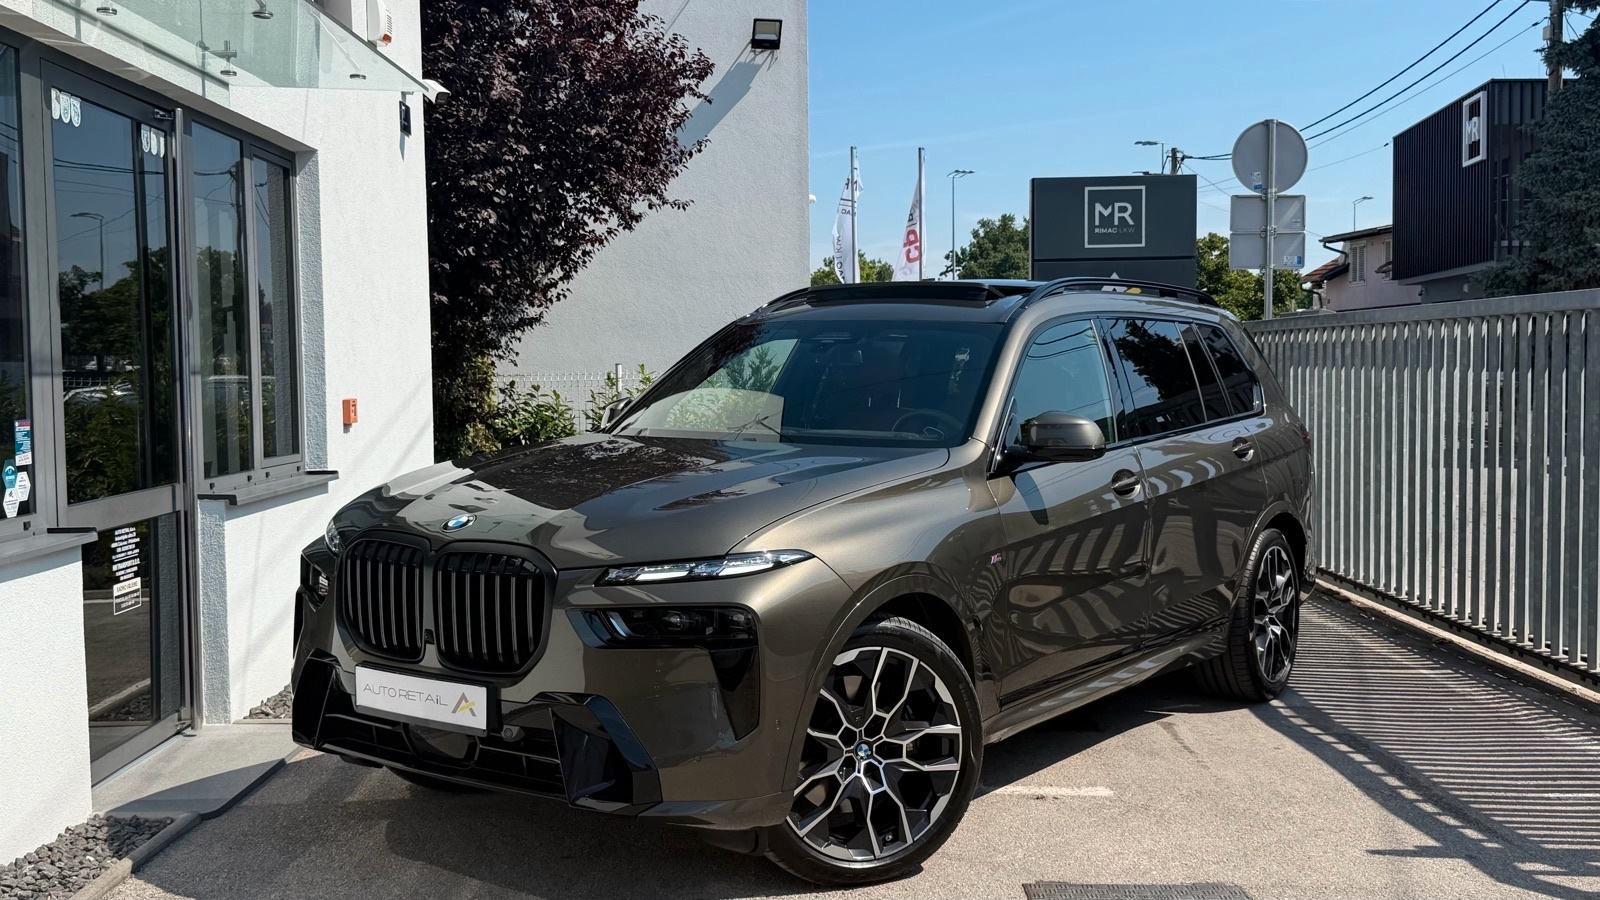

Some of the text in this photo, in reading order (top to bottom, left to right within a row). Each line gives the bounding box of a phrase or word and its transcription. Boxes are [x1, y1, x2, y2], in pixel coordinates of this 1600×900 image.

[1466, 116, 1481, 145] MR
[1094, 202, 1135, 226] MR
[363, 683, 397, 698] AUTO
